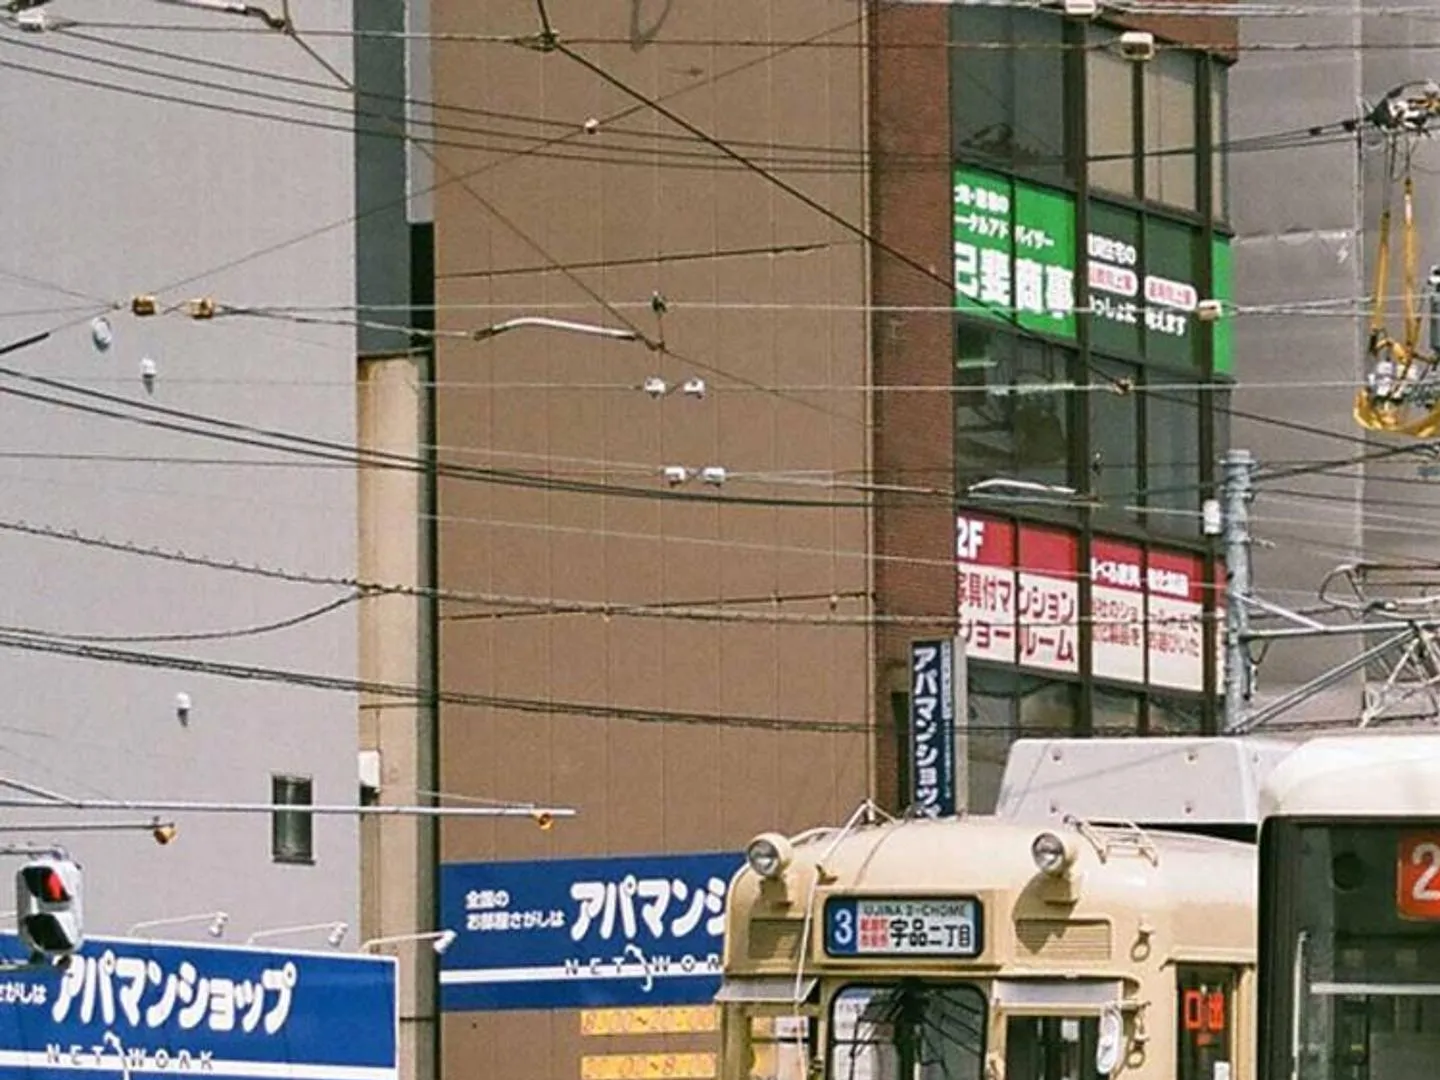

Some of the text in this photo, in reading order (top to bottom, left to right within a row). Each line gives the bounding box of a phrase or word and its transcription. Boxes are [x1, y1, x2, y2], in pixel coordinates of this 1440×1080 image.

[957, 516, 984, 559] 2F
[833, 908, 854, 945] 3
[889, 919, 971, 948] 宇品二丁目
[52, 949, 297, 1035] アパマンショップ
